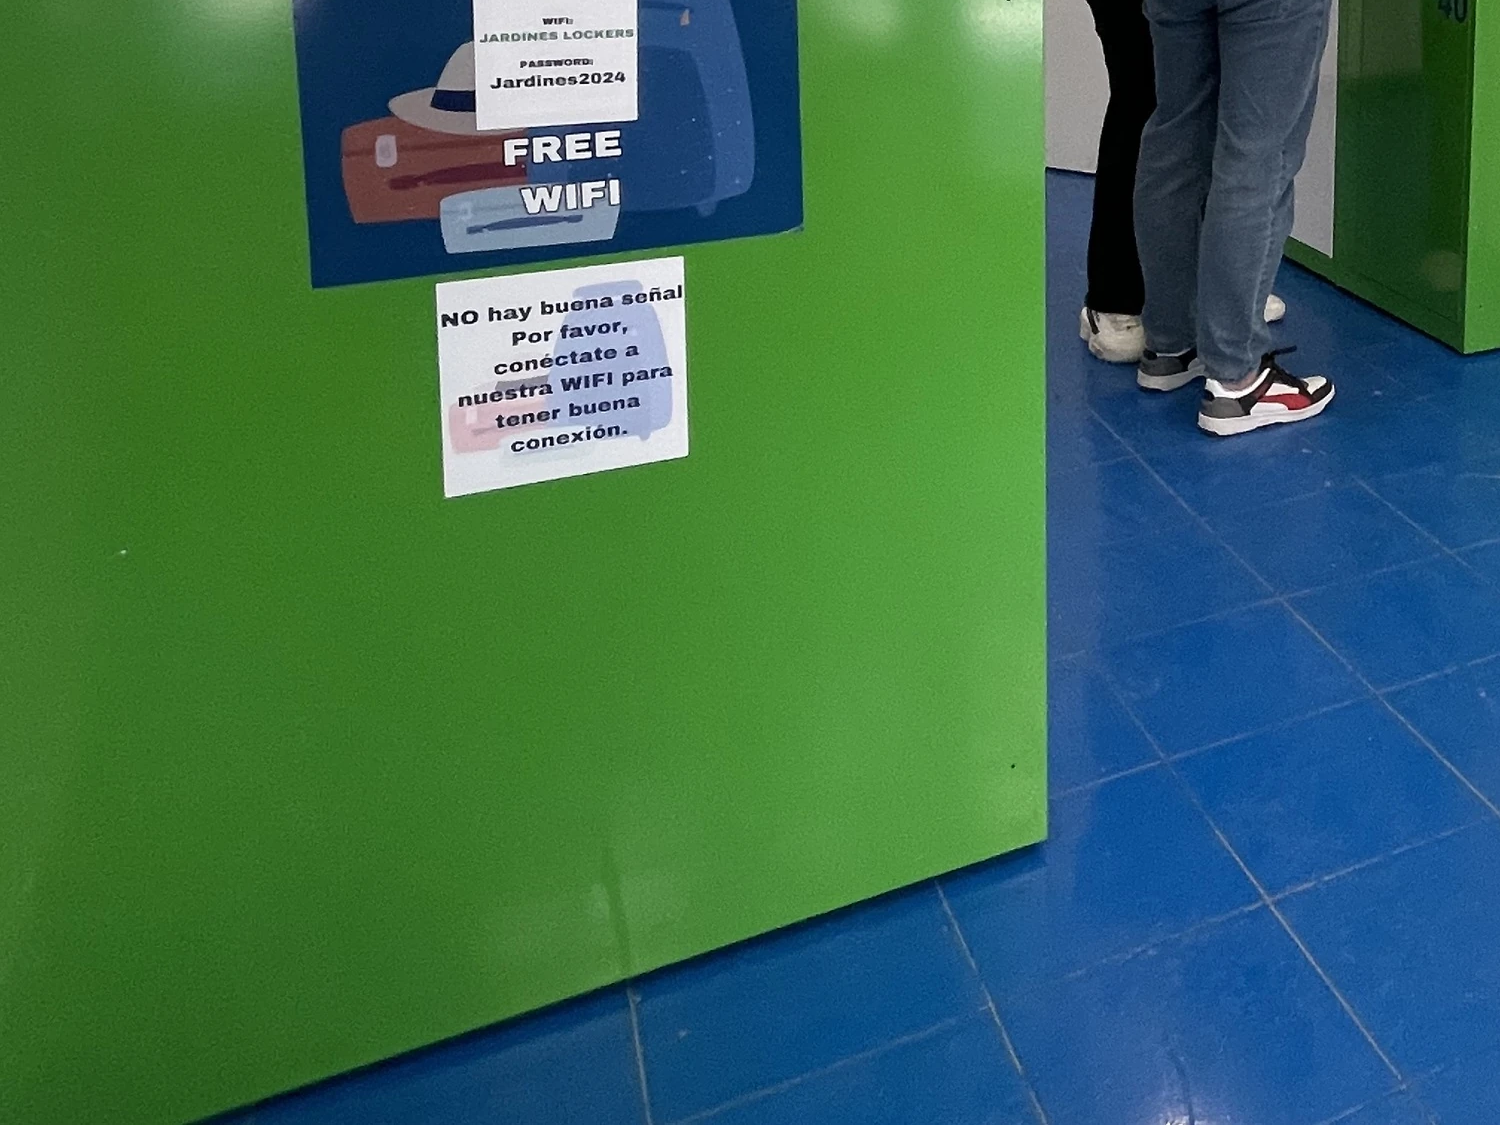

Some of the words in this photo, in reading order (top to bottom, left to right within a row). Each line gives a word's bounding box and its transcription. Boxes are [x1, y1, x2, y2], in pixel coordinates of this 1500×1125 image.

[480, 31, 558, 43] JARDINES
[563, 29, 634, 40] LOCKERS
[490, 72, 626, 89] Jardines2024
[503, 130, 623, 167] FREE
[521, 179, 621, 215] WIFI
[441, 310, 479, 328] NO
[488, 306, 532, 322] hay
[540, 295, 614, 316] buena
[621, 285, 682, 305] señal
[512, 329, 553, 346] Por
[561, 319, 628, 340] favor,
[494, 347, 617, 375] conéctate
[625, 345, 640, 357] a
[458, 381, 553, 408] nuestra
[560, 372, 613, 393] WIFI
[622, 365, 673, 386] para
[495, 407, 561, 430] tener
[569, 396, 641, 418] buena
[511, 423, 628, 453] conexión.
